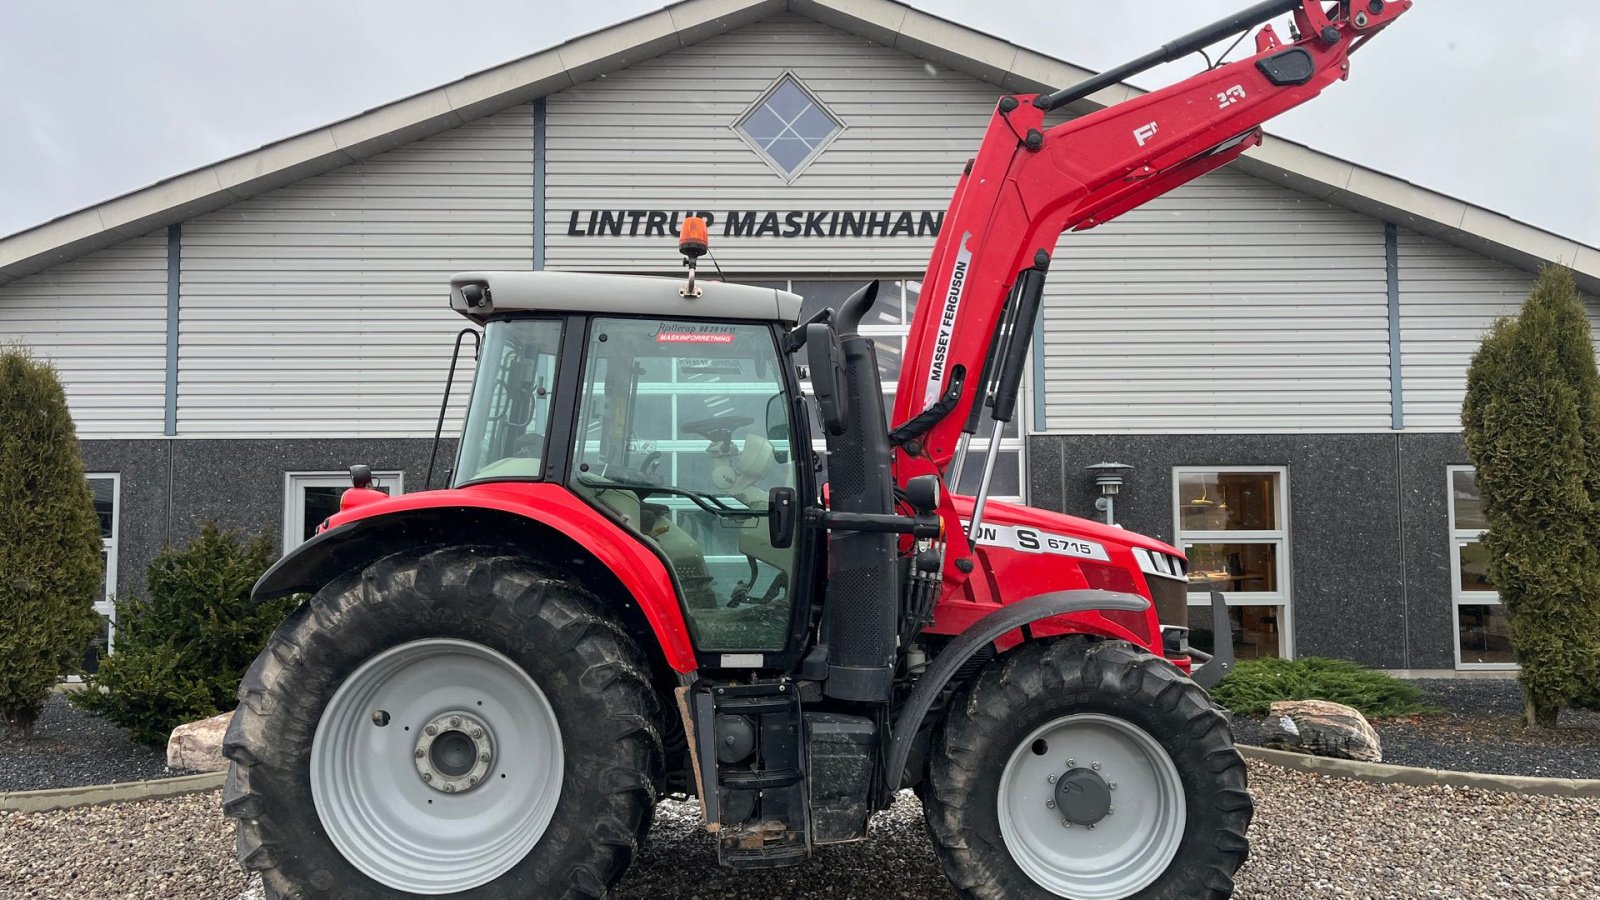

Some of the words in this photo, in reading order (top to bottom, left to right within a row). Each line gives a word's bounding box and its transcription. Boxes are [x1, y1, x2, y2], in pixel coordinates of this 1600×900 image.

[723, 210, 945, 238] MASKINHAN
[930, 330, 950, 382] MASSEY
[942, 261, 967, 328] FERGUSON
[659, 334, 731, 342] MASKINFORRETNING
[1016, 528, 1041, 550] S
[1047, 538, 1092, 555] 6715
